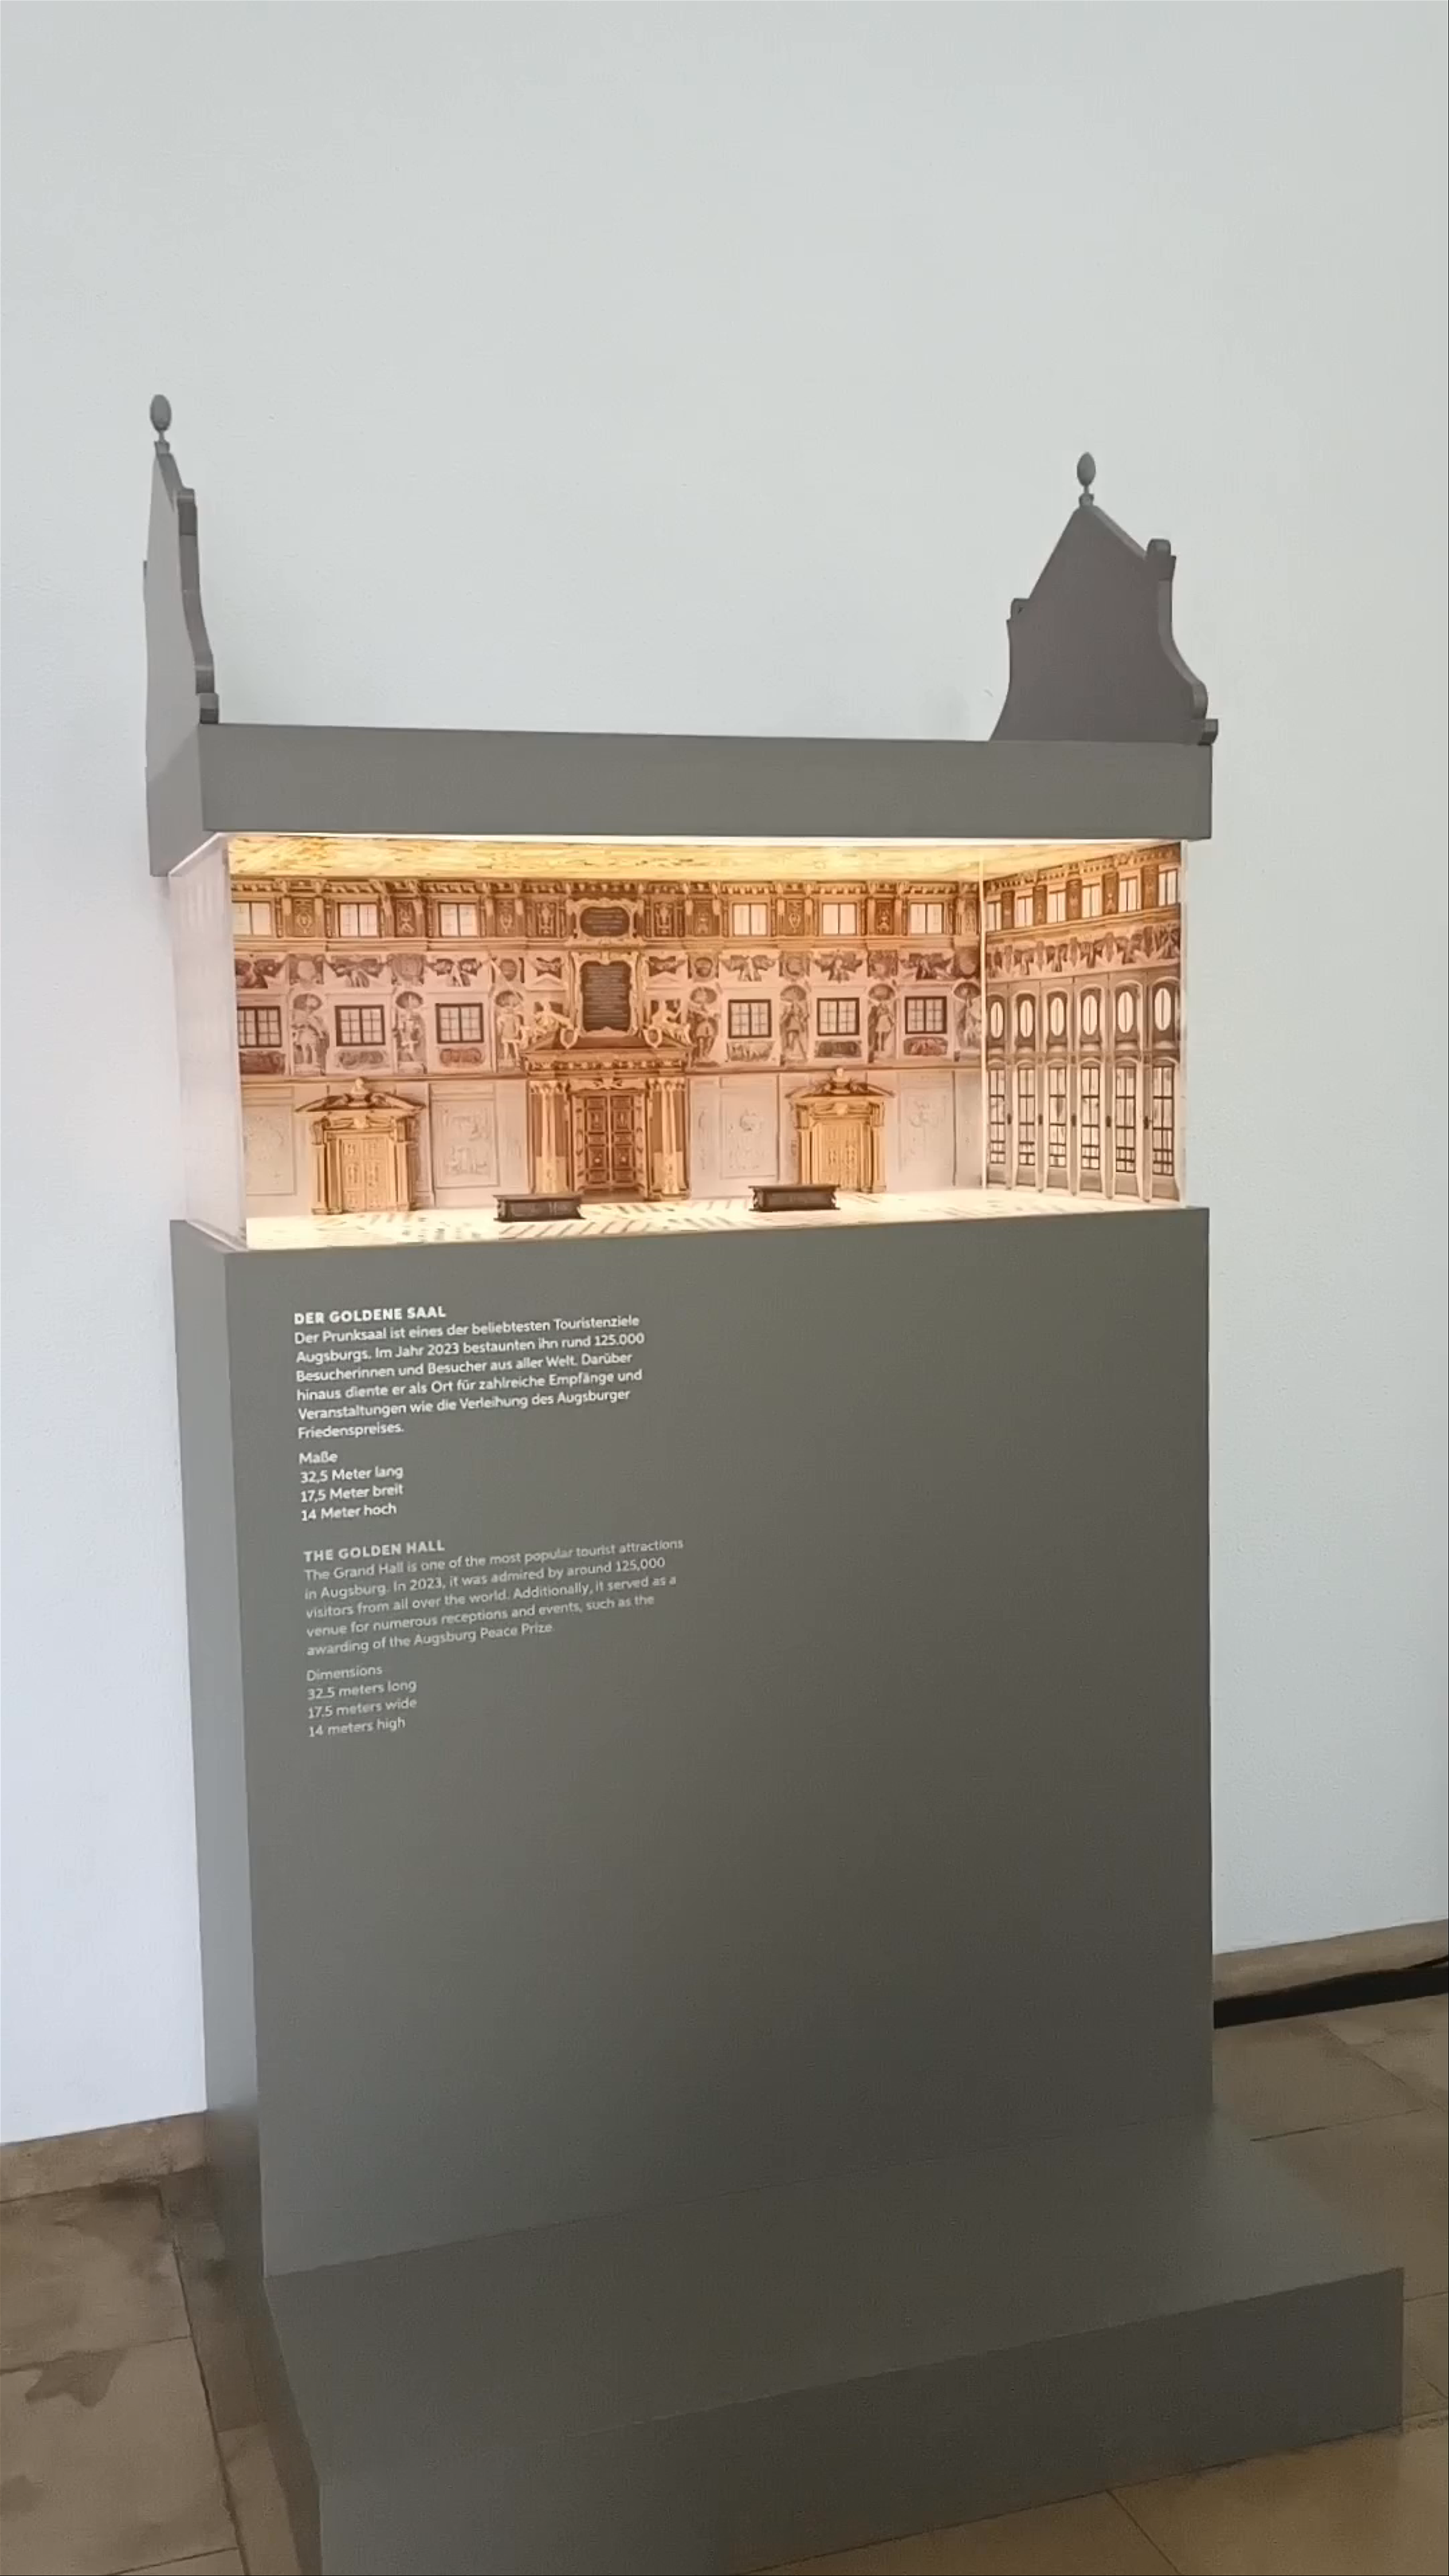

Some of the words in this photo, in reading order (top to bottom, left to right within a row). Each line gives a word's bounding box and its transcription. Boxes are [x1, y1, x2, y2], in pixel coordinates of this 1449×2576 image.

[294, 1312, 325, 1325] DER
[329, 1308, 403, 1323] GOLDENE
[407, 1306, 446, 1319] SAAL
[294, 1331, 320, 1344] Der
[322, 1327, 387, 1342] Prunksaal
[390, 1327, 405, 1339] ist
[409, 1325, 443, 1338] eines
[446, 1323, 469, 1336] der
[471, 1321, 551, 1335] beliebtesten
[554, 1314, 640, 1330] Touristenziele
[296, 1349, 372, 1365] Augsburgs.
[375, 1347, 392, 1358] Im
[395, 1345, 424, 1358] Jahr
[427, 1342, 459, 1356] 2023
[463, 1340, 535, 1354] bestaunten
[538, 1337, 558, 1349] ihn
[561, 1335, 591, 1348] rund
[595, 1332, 645, 1346] 125.000
[296, 1367, 395, 1382] Besucherinnen
[398, 1363, 424, 1376] und
[428, 1361, 487, 1375] Besucher
[490, 1361, 513, 1371] aus
[515, 1357, 544, 1369] aller
[545, 1355, 578, 1367] Welt.
[581, 1353, 632, 1366] Darüber
[297, 1389, 341, 1401] hinaus
[345, 1386, 389, 1398] diente
[392, 1386, 406, 1395] er
[408, 1381, 428, 1394] als
[431, 1380, 453, 1393] Ort
[457, 1379, 476, 1390] für
[478, 1375, 546, 1390] zahlreiche
[549, 1372, 614, 1387] Empfänge
[617, 1369, 643, 1382] und
[298, 1405, 407, 1420] Veranstaltungen
[409, 1400, 434, 1413] wie
[437, 1399, 457, 1411] die
[459, 1396, 528, 1409] Verleihung
[531, 1393, 554, 1405] des
[557, 1390, 631, 1406] Augsburger
[298, 1421, 404, 1439] Friedenspreises.
[299, 1450, 338, 1464] Maße
[300, 1470, 328, 1484] 32,5
[332, 1468, 372, 1481] Meter
[375, 1466, 404, 1479] lang
[301, 1489, 326, 1503] 17,5
[329, 1487, 370, 1500] Meter
[372, 1483, 403, 1497] breit
[301, 1509, 317, 1521] 14
[321, 1507, 361, 1519] Meter
[364, 1502, 397, 1516] hoch
[303, 1549, 334, 1562] THE
[338, 1543, 401, 1559] GOLDEN
[406, 1539, 445, 1554] HALL
[304, 1569, 330, 1581] The
[333, 1563, 375, 1579] Grand
[378, 1561, 404, 1575] Hall
[407, 1561, 417, 1572] is
[420, 1561, 446, 1571] one
[448, 1555, 462, 1569] of
[465, 1555, 486, 1567] the
[489, 1552, 521, 1565] most
[525, 1548, 573, 1565] popular
[576, 1544, 615, 1557] tourist
[619, 1539, 684, 1554] attractions
[305, 1588, 317, 1600] in
[393, 1580, 406, 1592] In
[409, 1577, 446, 1591] 2023,
[449, 1575, 458, 1587] it
[461, 1575, 488, 1586] was
[491, 1567, 544, 1583] admired
[548, 1567, 564, 1580] by
[567, 1561, 612, 1576] around
[616, 1556, 666, 1572] 125,000
[306, 1606, 354, 1619] visitors
[357, 1602, 389, 1615] from
[393, 1597, 408, 1610] all
[412, 1598, 441, 1609] over
[444, 1593, 466, 1606] the
[513, 1582, 593, 1599] Additionally,
[595, 1581, 604, 1592] it
[607, 1576, 649, 1592] served
[652, 1577, 666, 1586] as
[669, 1576, 676, 1585] a
[306, 1625, 348, 1638] venue
[350, 1621, 370, 1633] for
[373, 1616, 438, 1631] numerous
[441, 1609, 508, 1625] receptions
[511, 1604, 535, 1618] and
[538, 1602, 583, 1615] events,
[586, 1598, 615, 1610] such
[618, 1598, 632, 1608] as
[634, 1594, 655, 1606] the
[306, 1641, 369, 1656] awarding
[372, 1636, 386, 1649] of
[389, 1636, 411, 1647] the
[414, 1631, 476, 1647] Augsburg
[480, 1627, 518, 1639] Peace
[306, 1665, 383, 1681] Dimensions
[308, 1687, 335, 1700] 32.5
[338, 1684, 385, 1696] meters
[388, 1680, 417, 1693] long
[308, 1705, 333, 1719] 17.5
[336, 1702, 382, 1716] meters
[385, 1697, 417, 1710] wide
[309, 1724, 323, 1738] 14
[328, 1722, 374, 1735] meters
[377, 1716, 406, 1732] high
